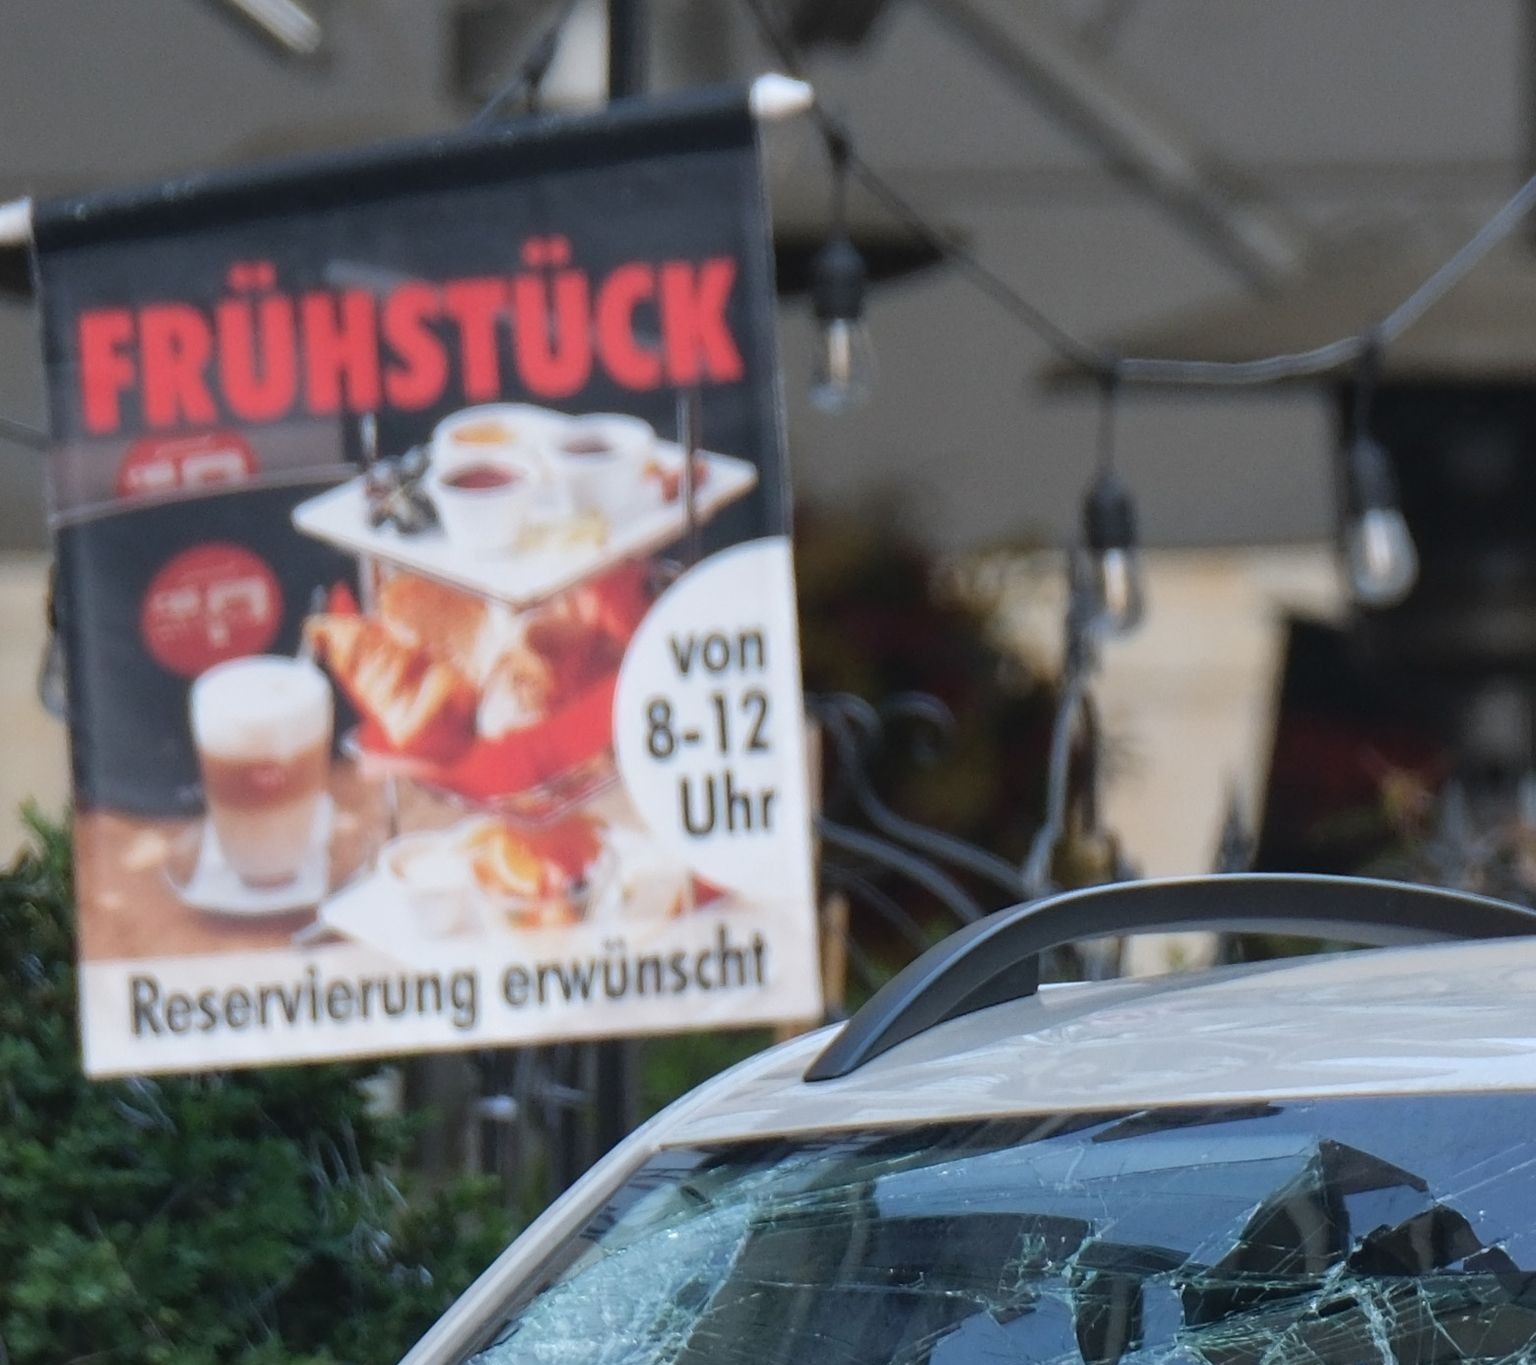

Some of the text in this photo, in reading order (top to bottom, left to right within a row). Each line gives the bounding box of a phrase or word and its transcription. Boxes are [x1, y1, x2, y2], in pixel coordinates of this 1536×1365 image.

[80, 234, 744, 434] FRÜHSTÜCK
[670, 631, 766, 675] von
[646, 691, 772, 759] 8-12
[680, 770, 776, 836] Uhr
[128, 923, 769, 1038] Reservierung erwünscht
